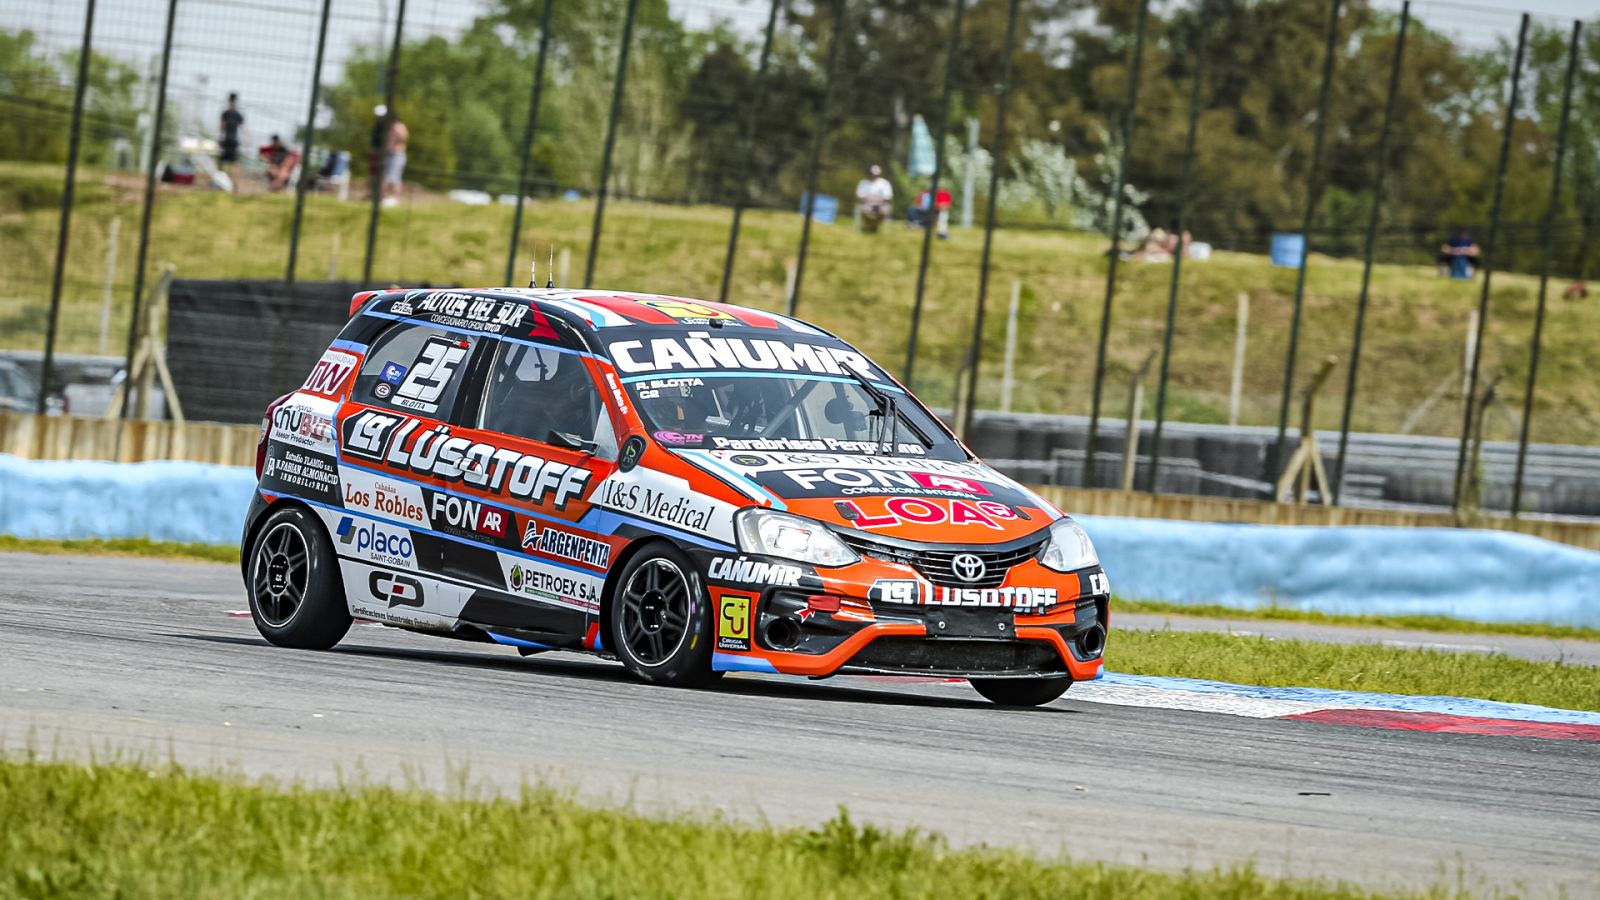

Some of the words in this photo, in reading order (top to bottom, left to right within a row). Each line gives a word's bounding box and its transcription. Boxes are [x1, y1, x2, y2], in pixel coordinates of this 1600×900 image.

[417, 291, 472, 317] AUTOS
[466, 296, 496, 322] DEL
[491, 301, 529, 328] SUR
[396, 341, 467, 403] 25
[650, 377, 704, 389] BLOTTA
[400, 399, 426, 410] BLOTTA
[290, 433, 316, 446] Productor
[712, 436, 827, 451] Parabrisas
[285, 450, 303, 464] Estudio
[782, 468, 921, 490] FON
[929, 475, 978, 492] AR
[841, 486, 924, 496] CONSULTORA
[922, 488, 981, 501] INTEGRAL
[344, 483, 370, 508] Los
[374, 490, 424, 522] Robles
[431, 492, 481, 531] FON
[482, 511, 502, 532] AR
[604, 479, 641, 511] I&S
[639, 488, 716, 532] Medical
[357, 522, 413, 559] placo
[540, 527, 611, 569] ARGENPENTA
[370, 552, 411, 568] SAINT-GOBAIN
[525, 568, 577, 597] PETROEX
[578, 583, 600, 603] S.A.
